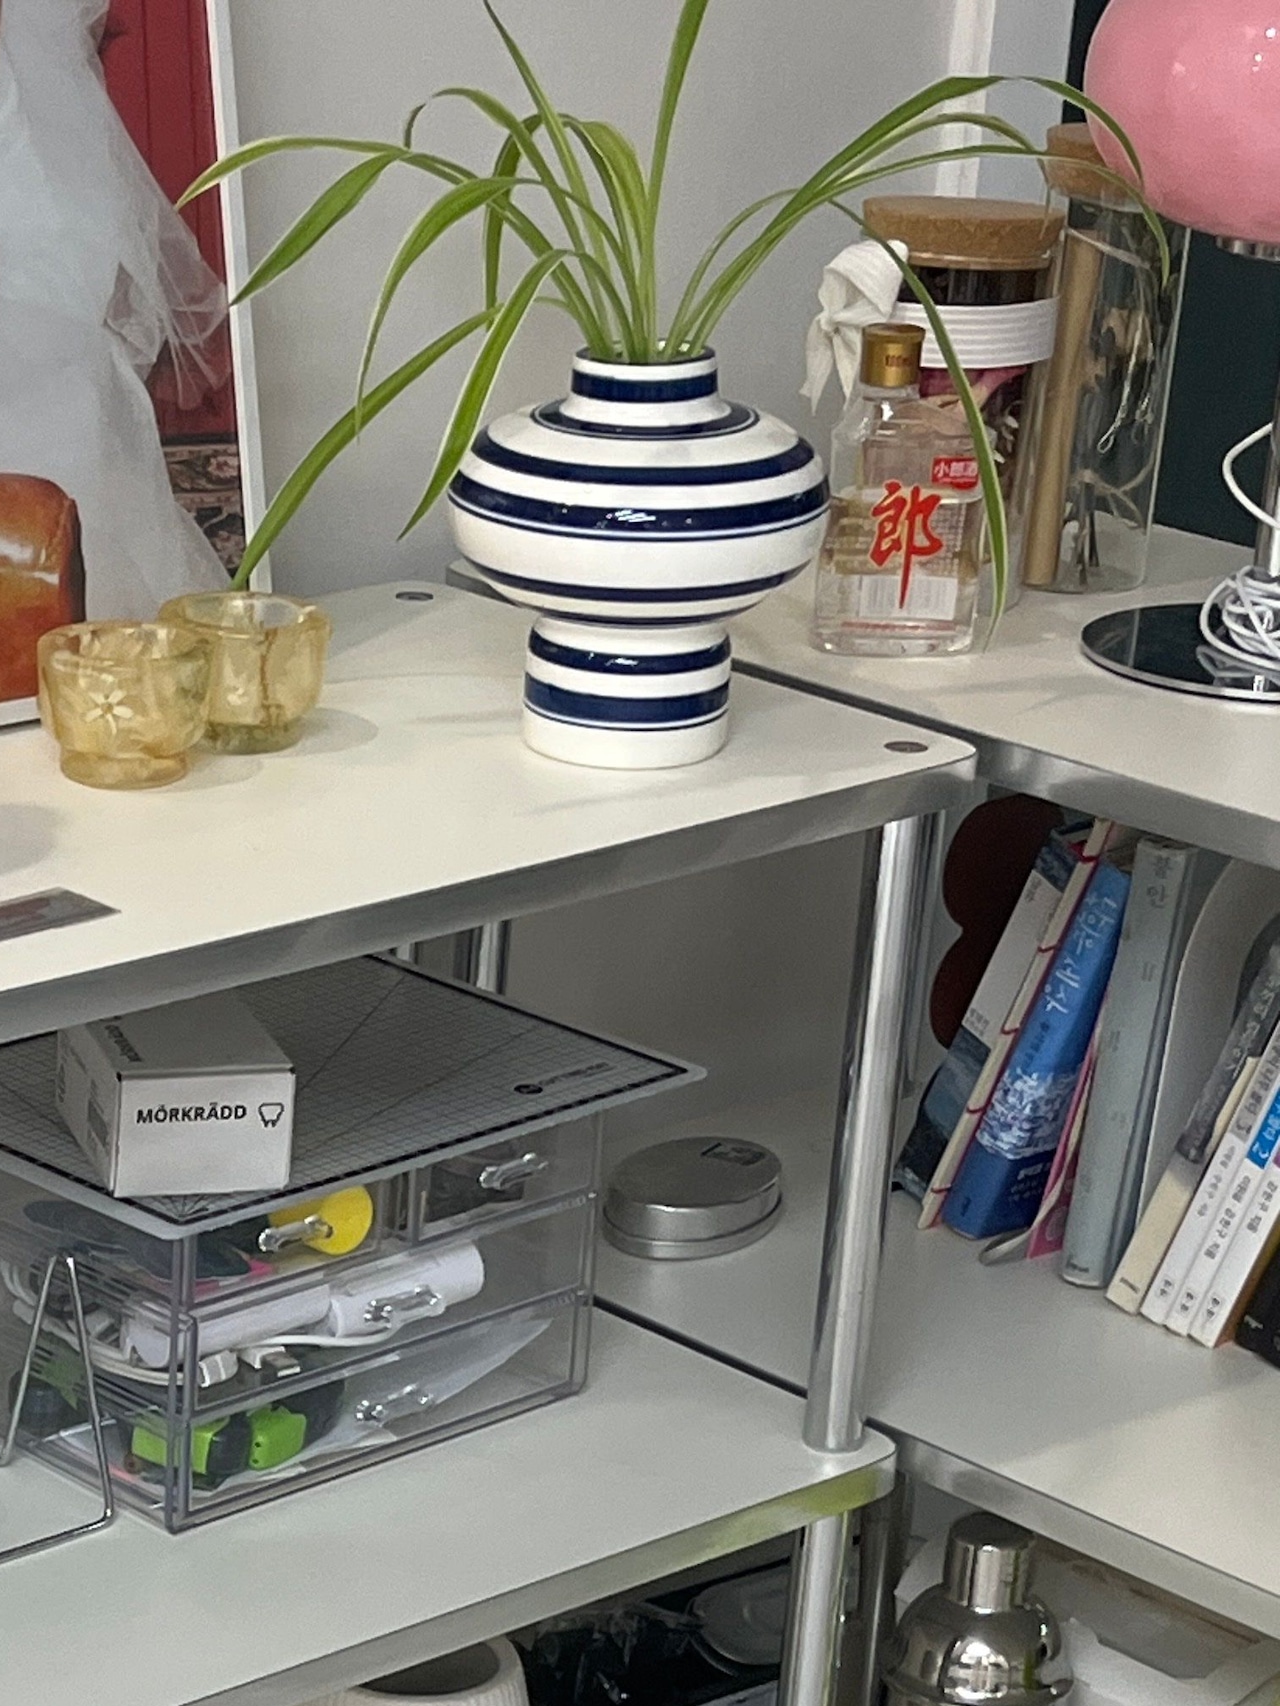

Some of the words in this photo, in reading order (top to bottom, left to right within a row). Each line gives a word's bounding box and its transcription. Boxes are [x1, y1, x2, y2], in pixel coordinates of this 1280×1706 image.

[870, 480, 943, 609] 郎
[1044, 957, 1082, 1015] 세상
[136, 1102, 247, 1124] MÖRKRÄDD
